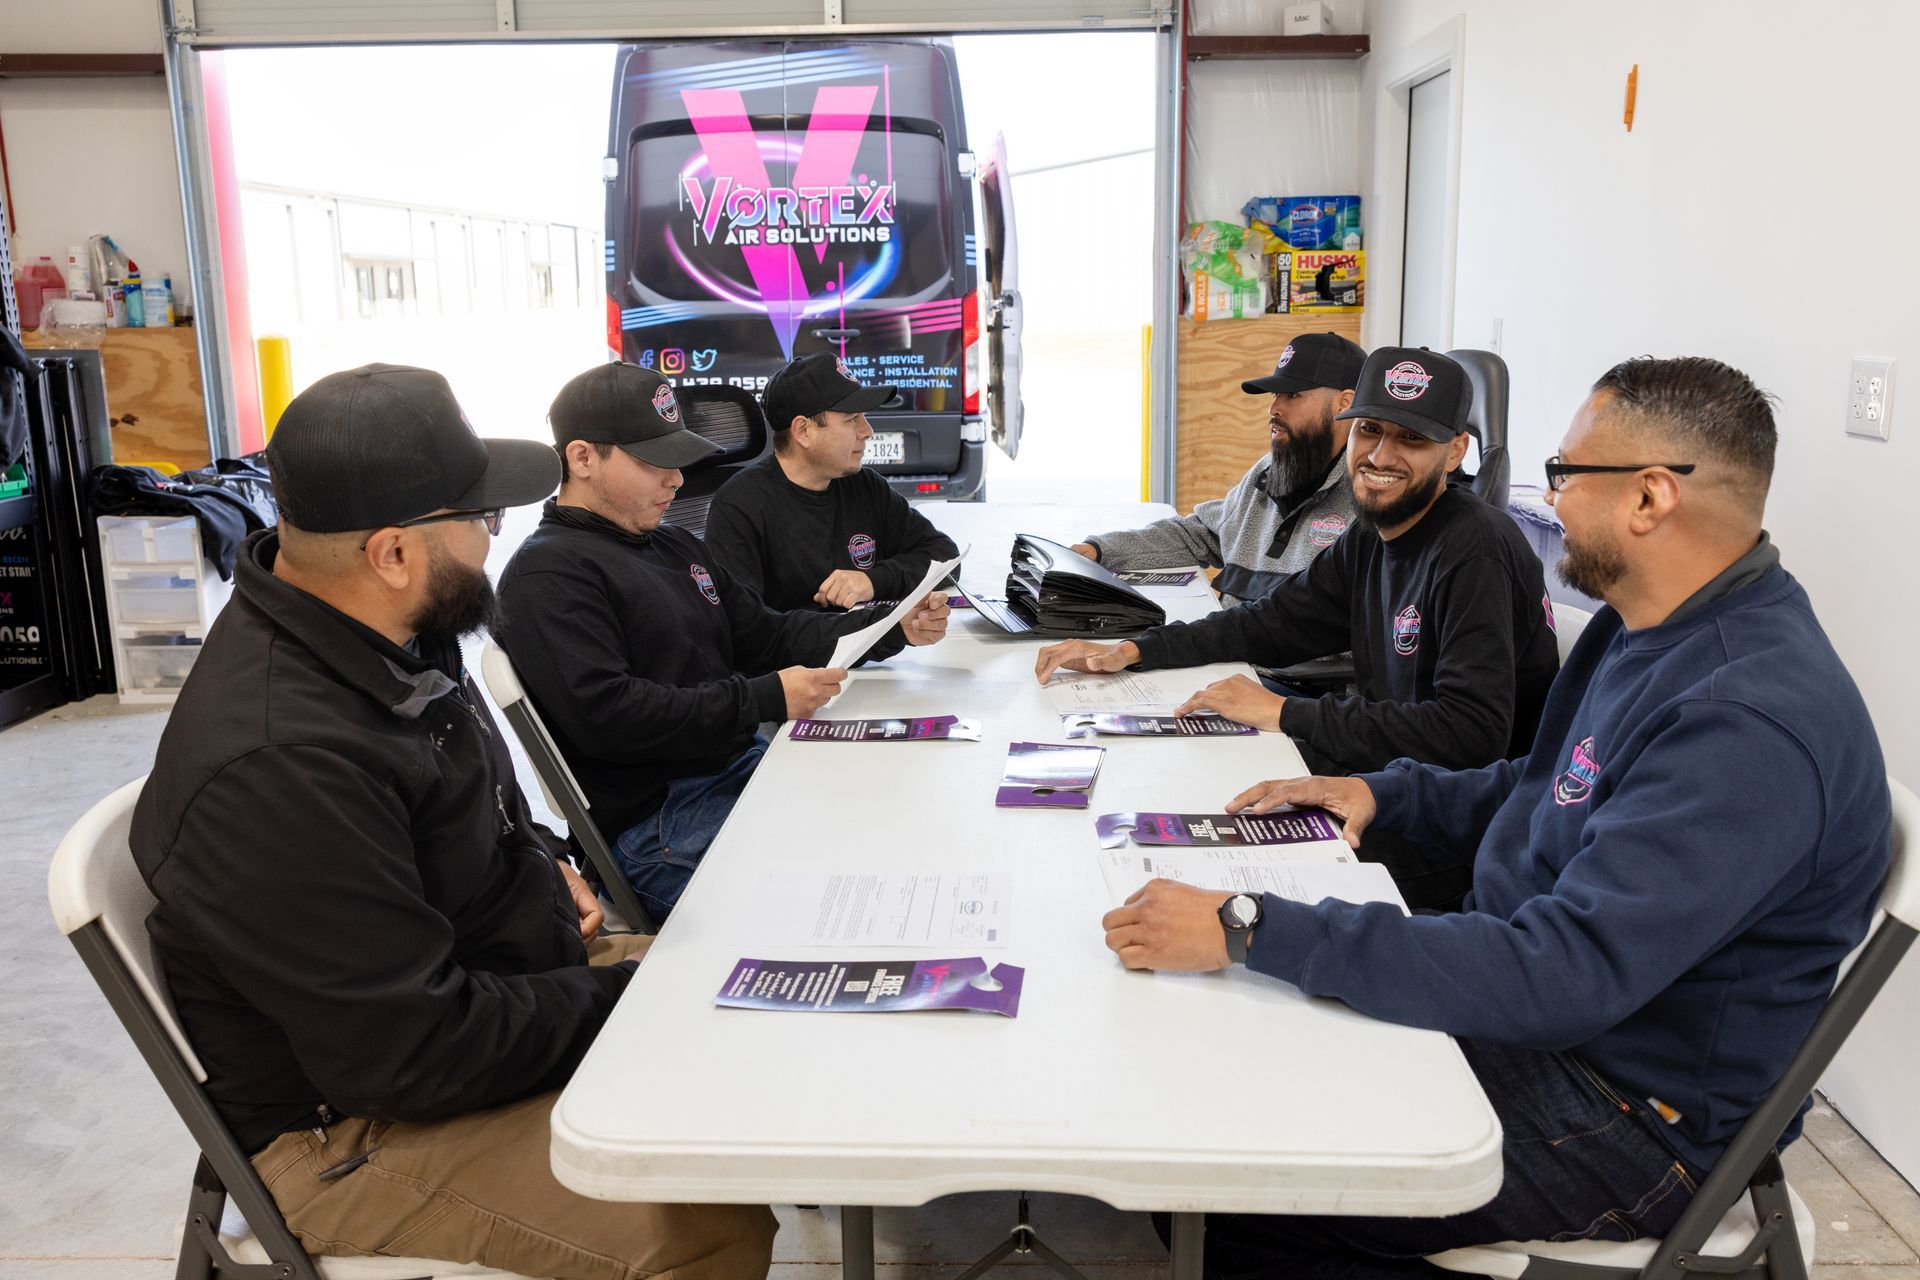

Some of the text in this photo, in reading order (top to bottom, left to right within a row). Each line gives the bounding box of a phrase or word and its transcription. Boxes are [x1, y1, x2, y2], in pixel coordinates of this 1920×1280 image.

[682, 176, 895, 244] VORTEX
[724, 227, 890, 244] AIR SOLUTIONS
[1297, 254, 1357, 269] HUSKY
[842, 355, 924, 366] ALES SERVICE
[885, 367, 958, 376] INSTALLATION
[1384, 369, 1434, 388] VORTEX
[873, 443, 899, 457] 1824
[8, 566, 36, 578] STAR
